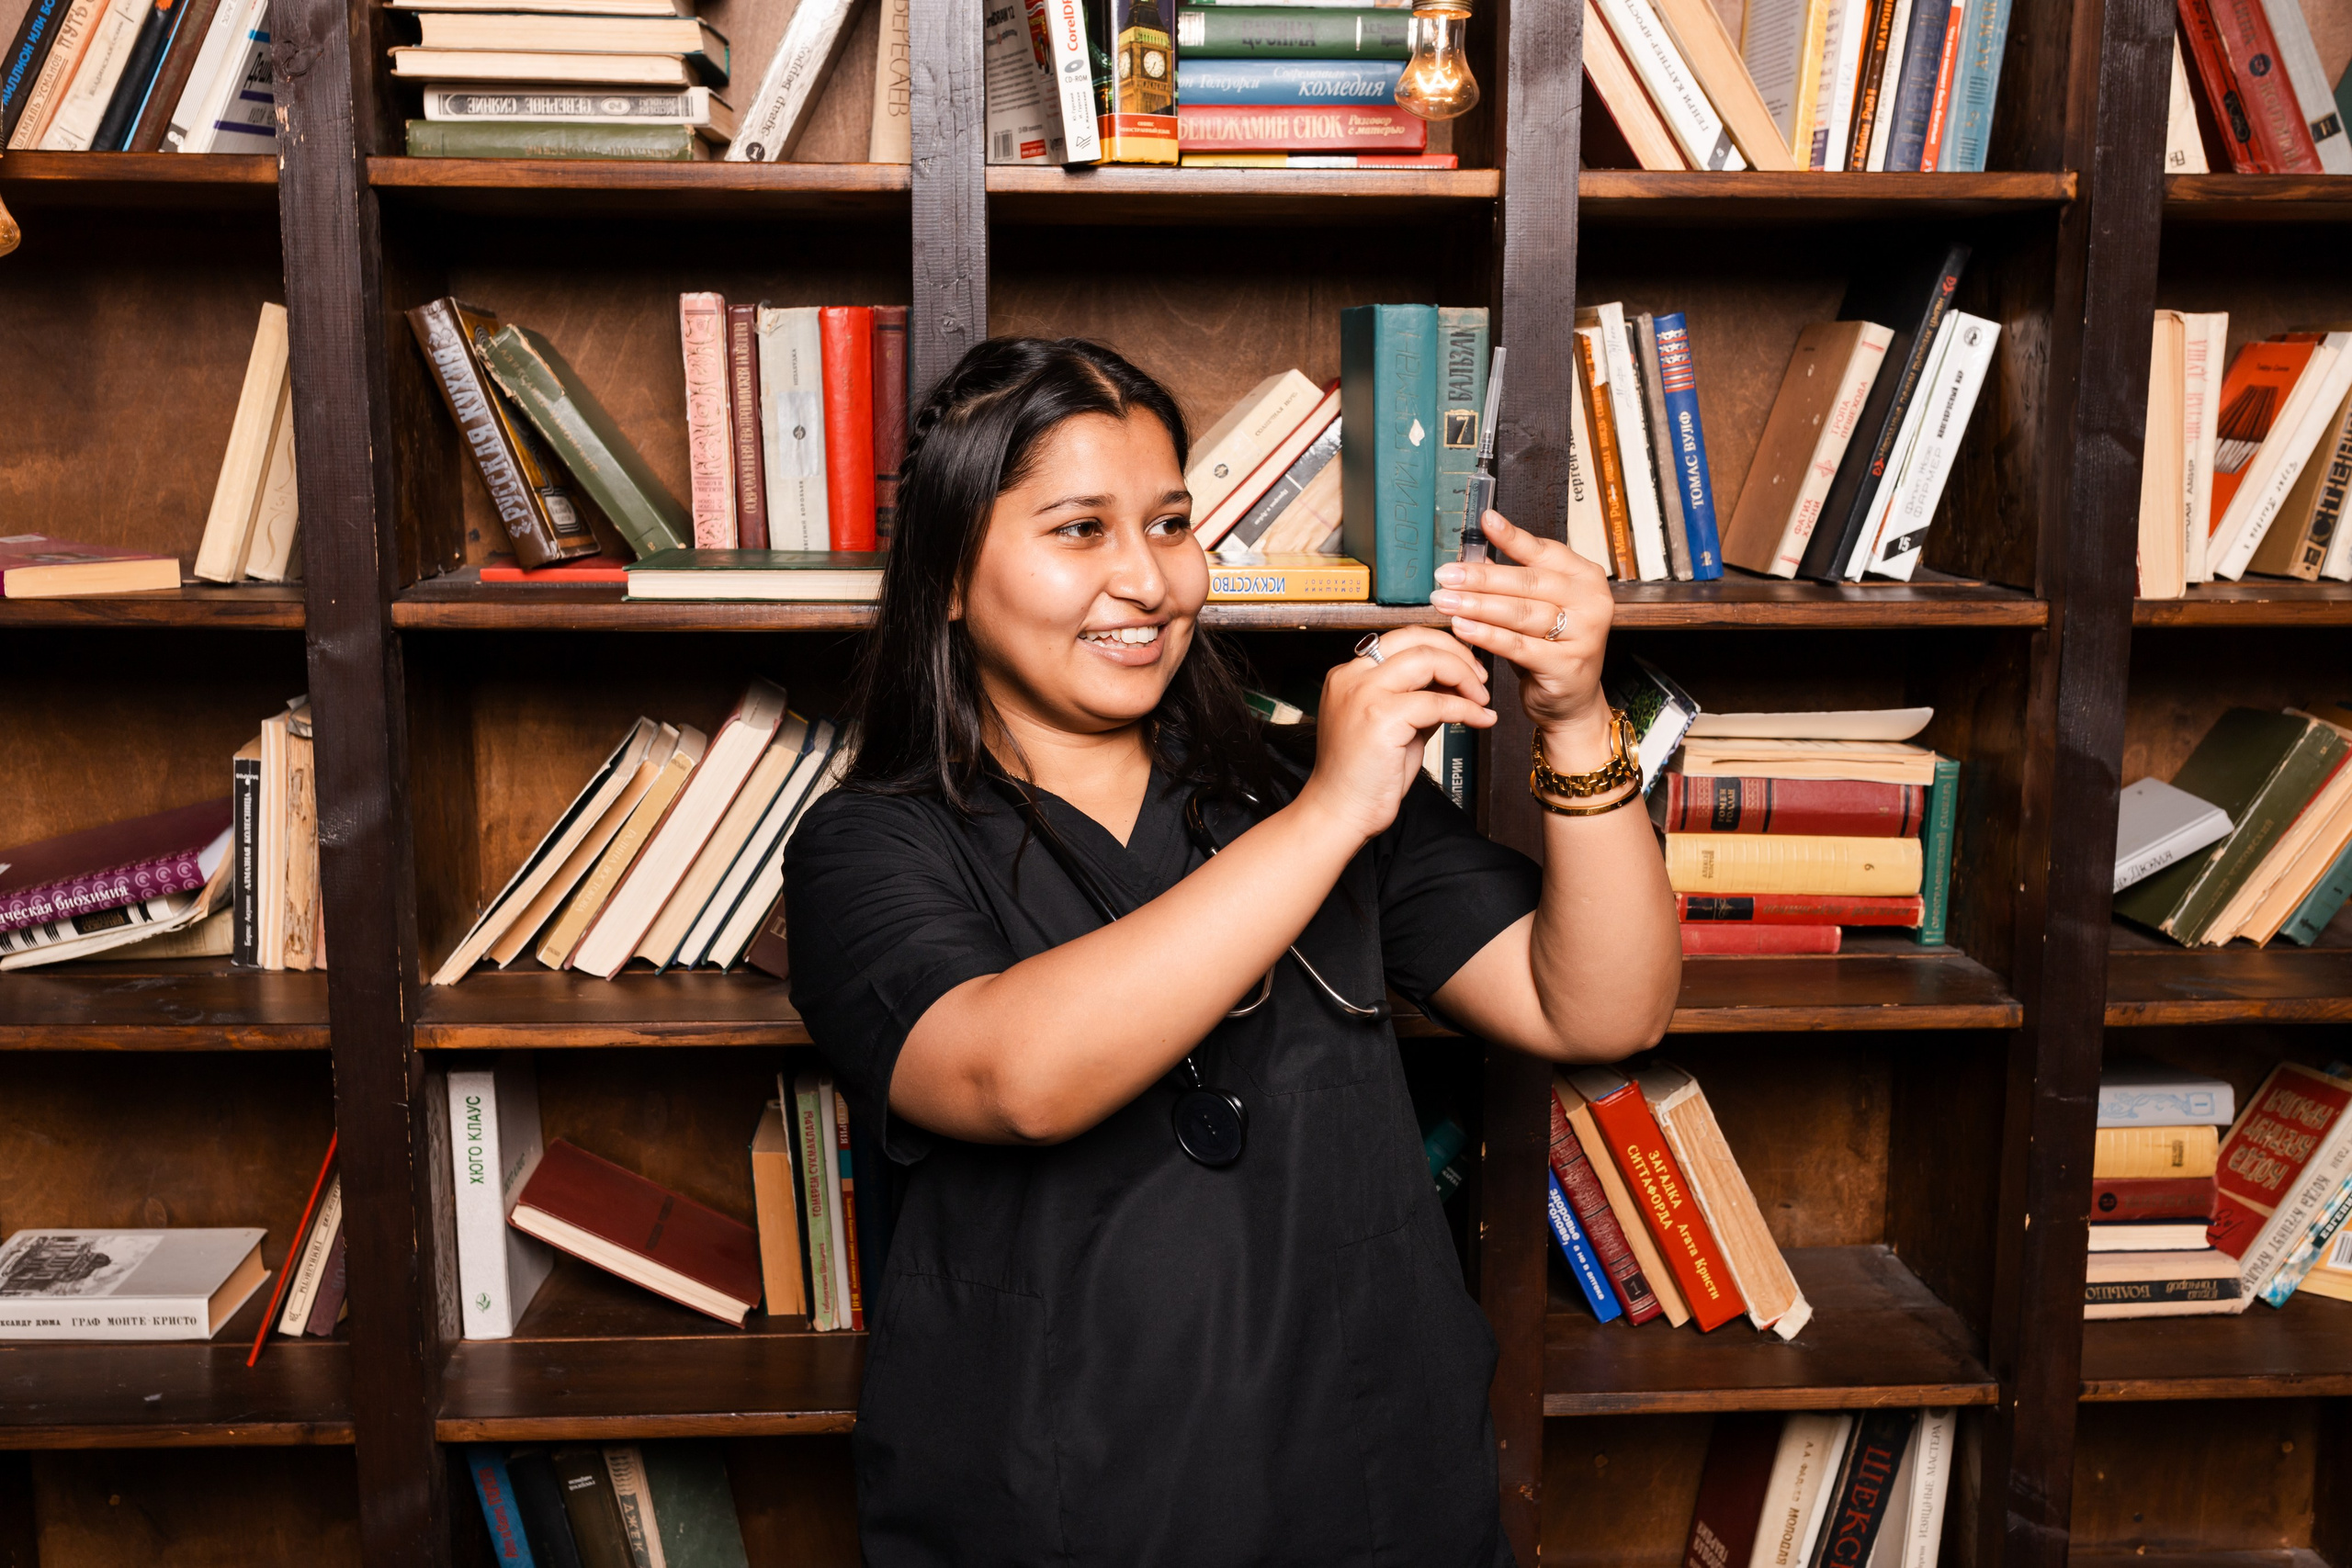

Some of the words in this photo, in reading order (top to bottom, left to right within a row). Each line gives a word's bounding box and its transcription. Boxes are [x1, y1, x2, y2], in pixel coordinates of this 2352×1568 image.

[56, 2, 89, 51] ПУТЬ
[0, 42, 34, 106] МИЛЛИОН
[26, 14, 47, 43] ИЛИ
[1065, 73, 1089, 85] CD-ROM
[14, 100, 41, 148] ШАМИЛЬ
[37, 52, 63, 100] УСМАНОВ
[1198, 73, 1261, 91] Галсуорси
[1297, 72, 1386, 97] комедия
[466, 96, 515, 113] СИЯНИЕ
[525, 96, 591, 113] СЕВЕРНОЕ
[759, 93, 787, 137] Эдгар
[1347, 114, 1393, 128] Разговор
[1681, 93, 1710, 132] ГЕНРИ
[1860, 95, 1875, 120] Рид
[1178, 116, 1289, 141] БЕНДЖАМИН
[1293, 114, 1344, 138] СПОК
[1356, 126, 1406, 137] матерью
[1853, 121, 1871, 159] Майн
[2187, 337, 2209, 381] ДУША
[432, 341, 488, 424] КУХНЯ
[1829, 397, 1851, 436] ТРОПА
[1838, 378, 1870, 439] ПЕШЕХОДА
[1455, 415, 1470, 445] 7
[1677, 409, 1696, 453] ВУЛФ
[466, 422, 528, 523] РУССКАЯ
[1684, 454, 1705, 509] ТОМАС
[1911, 446, 1944, 519] ФАРМЕР
[1395, 461, 1418, 551] ЮРИЙ
[1792, 496, 1814, 536] ФАТИХ
[1801, 499, 1822, 538] ХУСНИ
[1611, 519, 1626, 554] Майн
[1898, 536, 1912, 552] 15
[1699, 549, 1713, 567] 2
[1212, 576, 1285, 592] ИСКУССТВО
[1717, 787, 1727, 822] РОМЕН
[1724, 787, 1735, 823] РОЛЛАН
[607, 828, 638, 865] ГАЛИНА
[1930, 831, 1947, 930] ОРФОГРАФИЧЕСКИЙ
[1939, 781, 1951, 828] СЛОВАРЬ
[243, 846, 252, 890] АЛМАЗНАЯ
[574, 863, 613, 914] ВОСТОКОВА
[52, 884, 130, 911] биохимия
[466, 1095, 481, 1141] КЛАУС
[803, 1110, 818, 1174] СУКМАКЛАРЫ
[468, 1145, 483, 1184] ХЮГО
[1646, 1148, 1683, 1209] ЗАГАДКА
[1625, 1143, 1675, 1230] СИТТАФОРДА
[1547, 1187, 1581, 1242] здоровье
[1576, 1251, 1586, 1264] не
[1585, 1269, 1605, 1301] аптеке
[1676, 1221, 1701, 1257] Агата
[1692, 1257, 1721, 1301] Кристи
[36, 1319, 62, 1327] ДЮМА
[72, 1317, 101, 1327] ГРАФ
[107, 1316, 198, 1327] МОНТЕ-КРИСТО
[1918, 1478, 1934, 1538] ИЗЯЩНЫЕ
[1926, 1422, 1941, 1476] МАСТЕРА
[622, 1501, 644, 1554] ДЖЕК
[1774, 1506, 1800, 1565] МОЛОДАЯ
